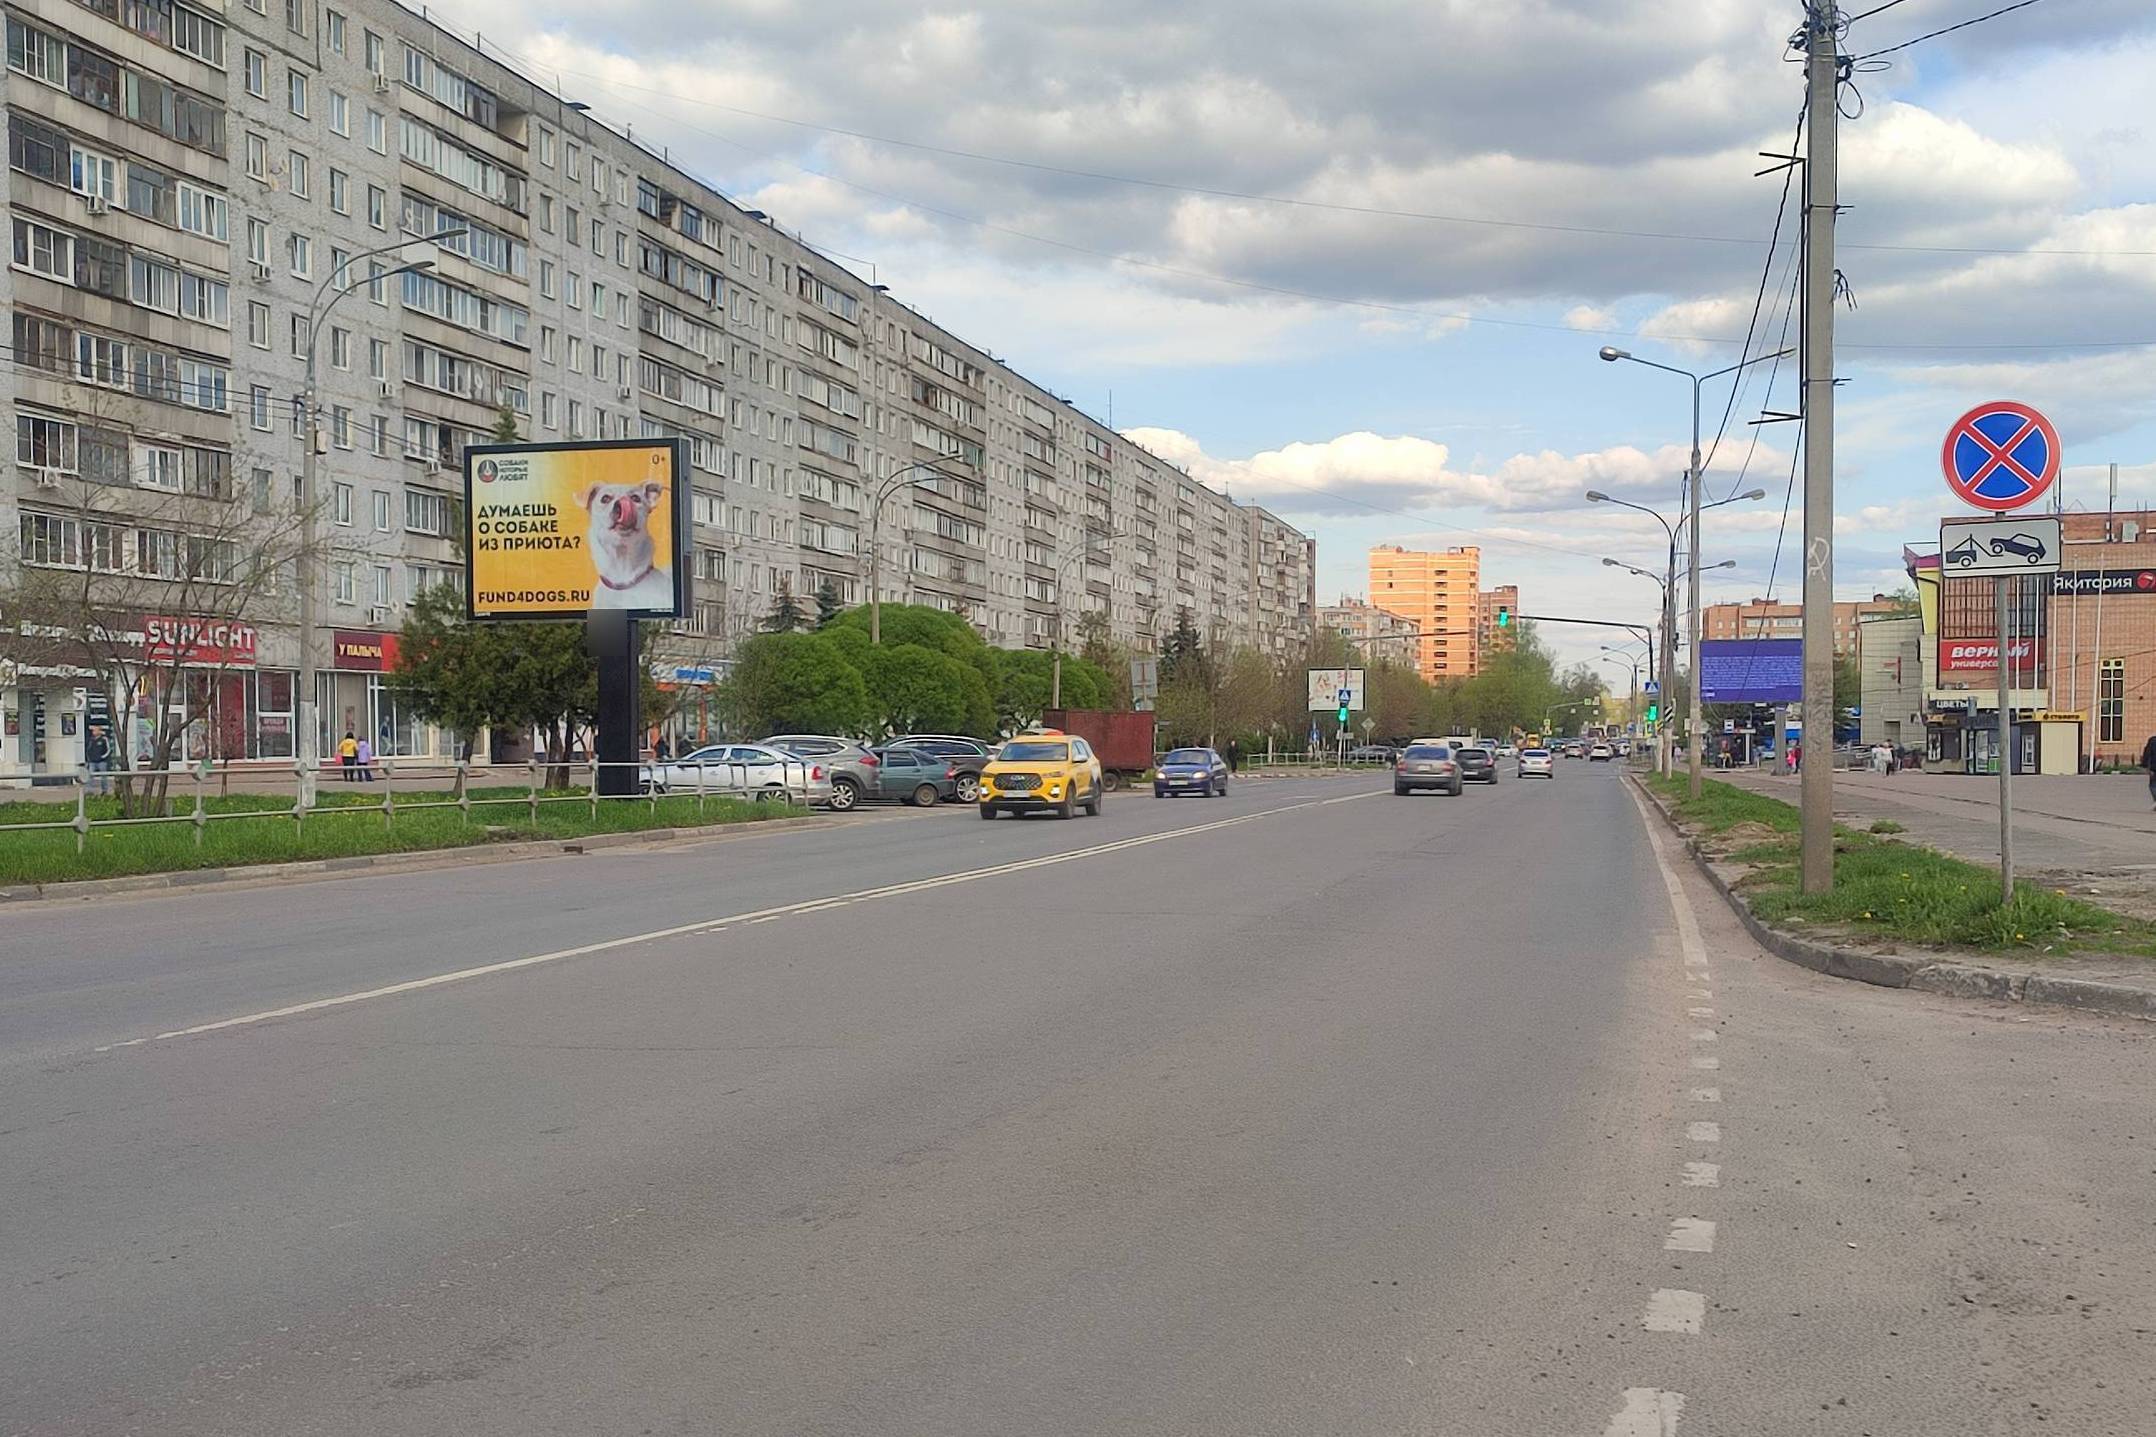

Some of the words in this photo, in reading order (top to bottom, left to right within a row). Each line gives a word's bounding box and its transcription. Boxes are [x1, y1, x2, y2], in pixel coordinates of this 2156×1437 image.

[477, 504, 557, 519] ДУМАЕШЬ
[478, 521, 490, 534] О
[494, 520, 558, 534] СОБАКЕ
[479, 538, 499, 551] ИЗ
[503, 536, 581, 550] ПРИЮТА?
[2054, 577, 2132, 590] Якитория
[478, 590, 590, 603] FUND4DOGS.RU
